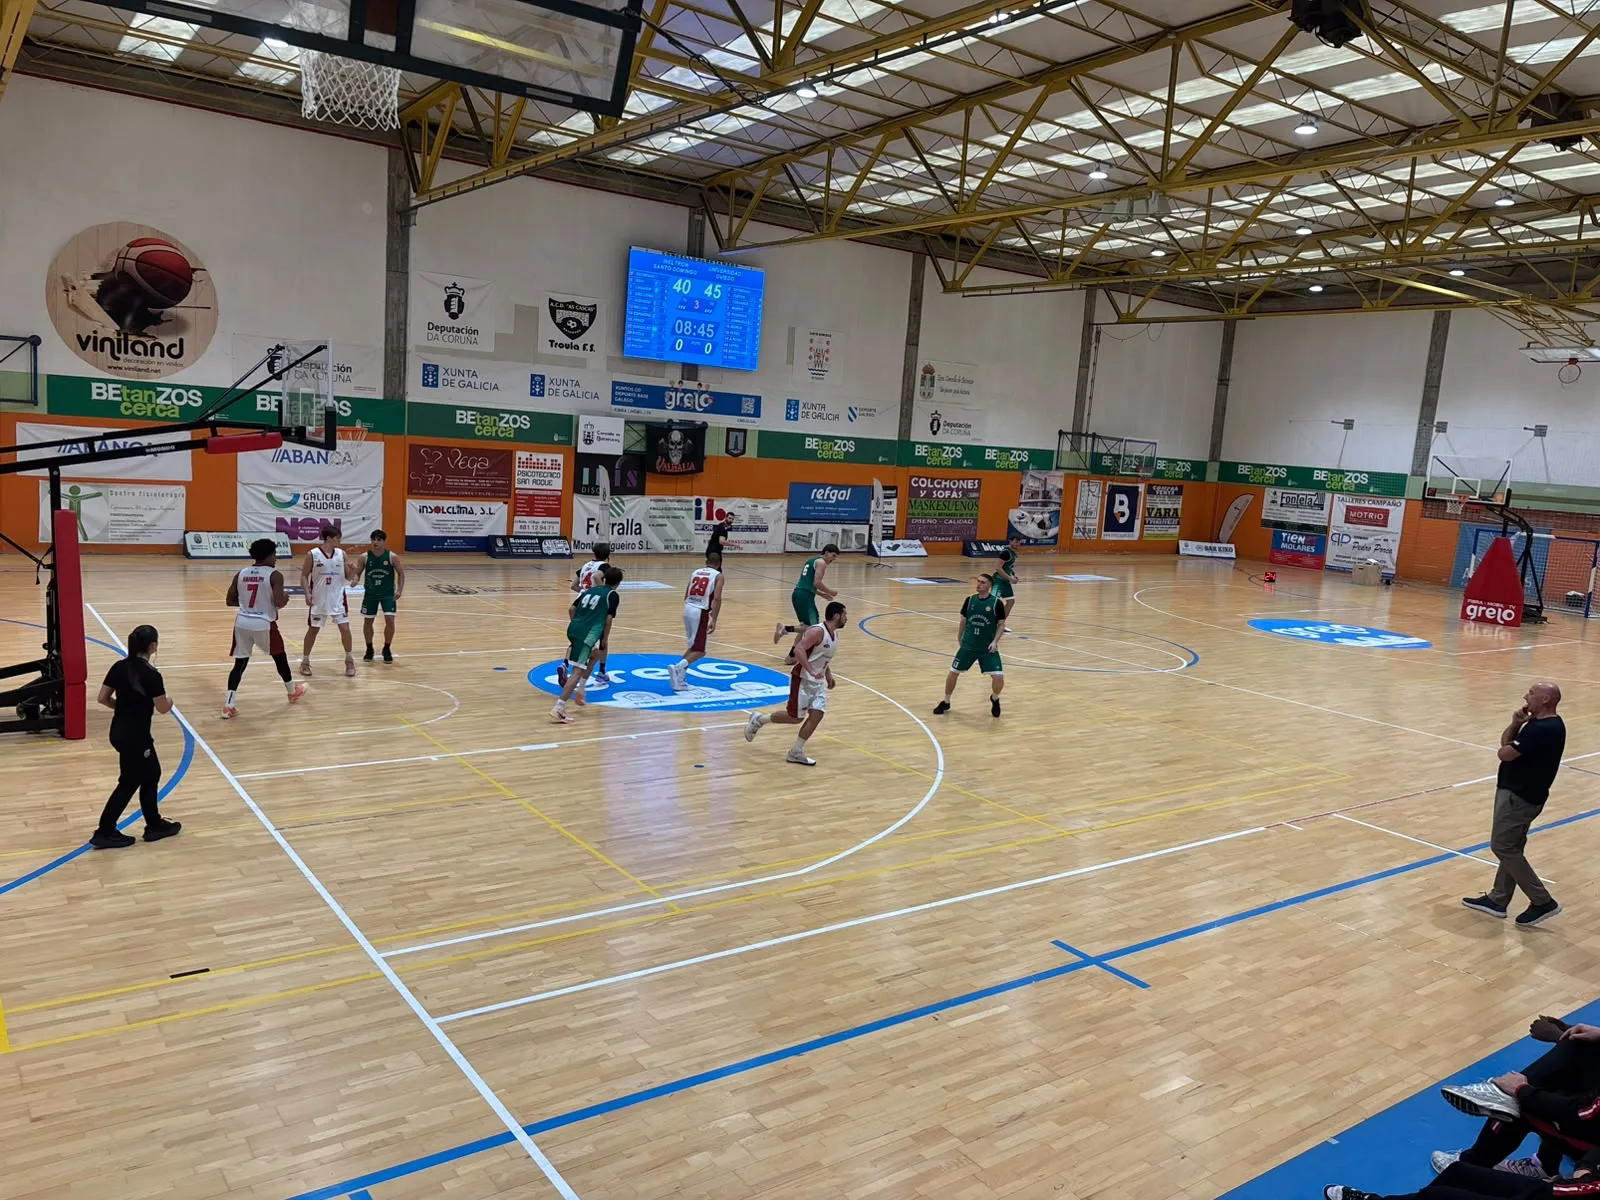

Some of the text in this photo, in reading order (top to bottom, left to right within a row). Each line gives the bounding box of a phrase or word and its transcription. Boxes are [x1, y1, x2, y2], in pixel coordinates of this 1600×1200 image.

[653, 264, 697, 276] SANTO DOMINGO
[708, 266, 741, 277] UNIVERSIDAD
[716, 274, 735, 282] OVIEDO
[672, 278, 722, 299] 40 45
[694, 300, 700, 310] 3
[427, 321, 479, 336] Deputación
[675, 319, 714, 338] 08:45
[426, 332, 478, 345] DA CORUÑA
[675, 338, 683, 350] 0
[76, 330, 184, 361] viniland
[549, 339, 579, 351] Troula
[704, 342, 712, 354] 0
[107, 364, 161, 374] www.viniland.net
[443, 367, 479, 379] XUNTA
[442, 378, 500, 391] DE GALICIA
[548, 377, 581, 388] XUNTA
[91, 381, 203, 407] BEtanZOS
[548, 388, 600, 400] DE GALICIA
[120, 401, 180, 418] cerca
[802, 402, 826, 411] XUNTA
[455, 409, 531, 430] BEtanZOS
[801, 411, 840, 421] DE GALICIA
[943, 420, 972, 428] Deputación
[475, 425, 514, 438] cerca
[805, 437, 856, 453] BEtanZOS
[915, 444, 962, 458] BEtanZOS
[817, 449, 845, 459] cerca
[985, 448, 1029, 462] BEtanZOS
[926, 455, 952, 466] cerca
[995, 460, 1019, 469] cerca
[1156, 460, 1191, 472] BEtanZOS
[1164, 469, 1184, 478] cerca
[1237, 464, 1287, 478] BEtanZOS
[1313, 469, 1369, 484] BEtanZOS
[911, 477, 979, 489] COLCHONES
[1249, 474, 1276, 484] cerca
[1326, 479, 1356, 491] cerca
[303, 492, 340, 501] GALICIA
[811, 486, 852, 503] refgal
[920, 489, 963, 498] Y SOFÁS
[303, 501, 351, 510] SAUDABLE
[1337, 496, 1402, 507] TALLERES CAMPAÑO
[480, 506, 496, 516] S.L.
[1146, 507, 1179, 518] VARA
[276, 517, 341, 541] NON
[212, 541, 244, 549] CLEAN
[1281, 543, 1316, 553] MOLARES
[1352, 541, 1371, 551] Pedro
[1264, 572, 1276, 581] 24
[247, 584, 258, 608] 7
[581, 593, 601, 610] 44
[1466, 604, 1515, 624] grelo
